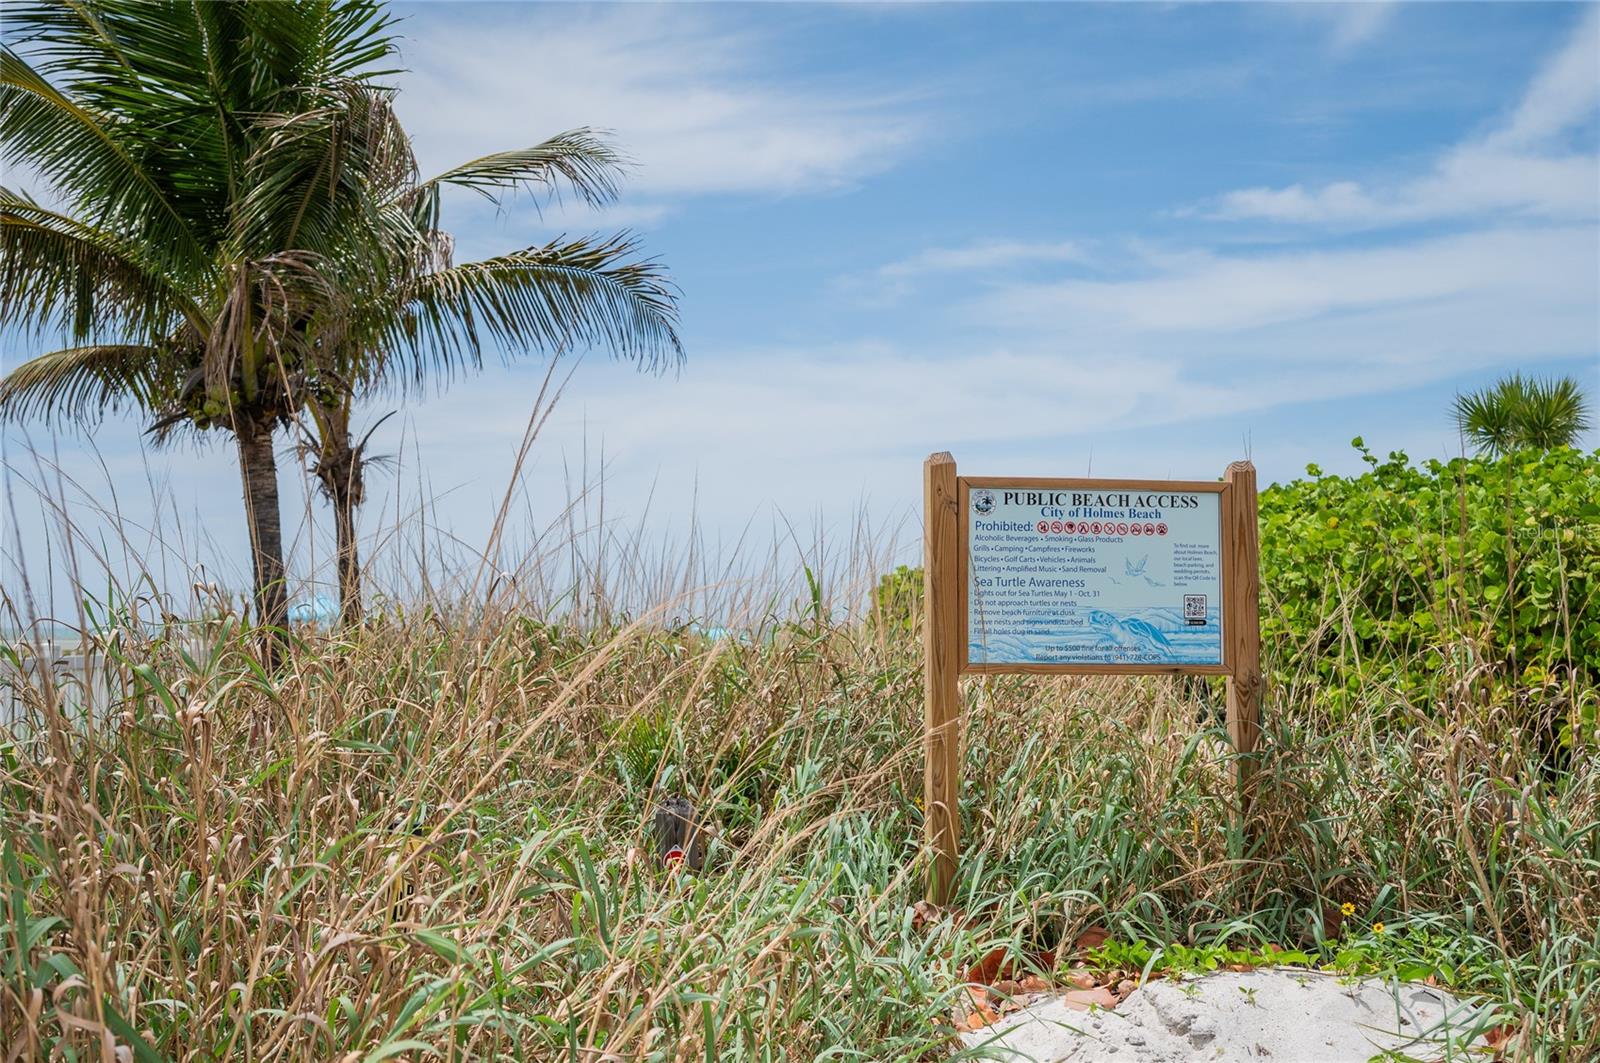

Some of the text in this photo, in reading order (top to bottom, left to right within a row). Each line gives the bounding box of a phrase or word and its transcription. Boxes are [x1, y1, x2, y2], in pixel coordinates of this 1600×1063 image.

[1003, 491, 1066, 506] PUBLIC
[1071, 493, 1130, 507] BEACH
[1134, 494, 1199, 509] ACCESS
[1040, 506, 1162, 520] City of Holmes Beach
[975, 520, 1034, 532] Prohibited:
[974, 533, 1124, 544] Alcoholic Beverages Smoking Glass Products
[973, 544, 1096, 553] Grills Camping Campfires Fireworks
[974, 555, 1000, 563] Bicycles
[974, 565, 1002, 573] Littering
[1005, 565, 1038, 573] Amplified
[1038, 565, 1058, 573] Music
[974, 576, 1086, 588] Sea Turtle Awareness
[974, 589, 993, 599] Lights
[1031, 590, 1053, 598] Turtles
[1054, 590, 1068, 599] May
[1078, 590, 1092, 598] Oct.
[1093, 590, 1101, 598] 31
[974, 599, 984, 607] Do
[997, 599, 1029, 608] approach
[974, 608, 1001, 616] Remove
[1022, 608, 1052, 616] furniture
[1012, 618, 1025, 626] and
[1025, 618, 1044, 627] signs
[1044, 618, 1084, 626] undisturbed
[1011, 628, 1026, 637] dug
[1064, 644, 1081, 652] $500
